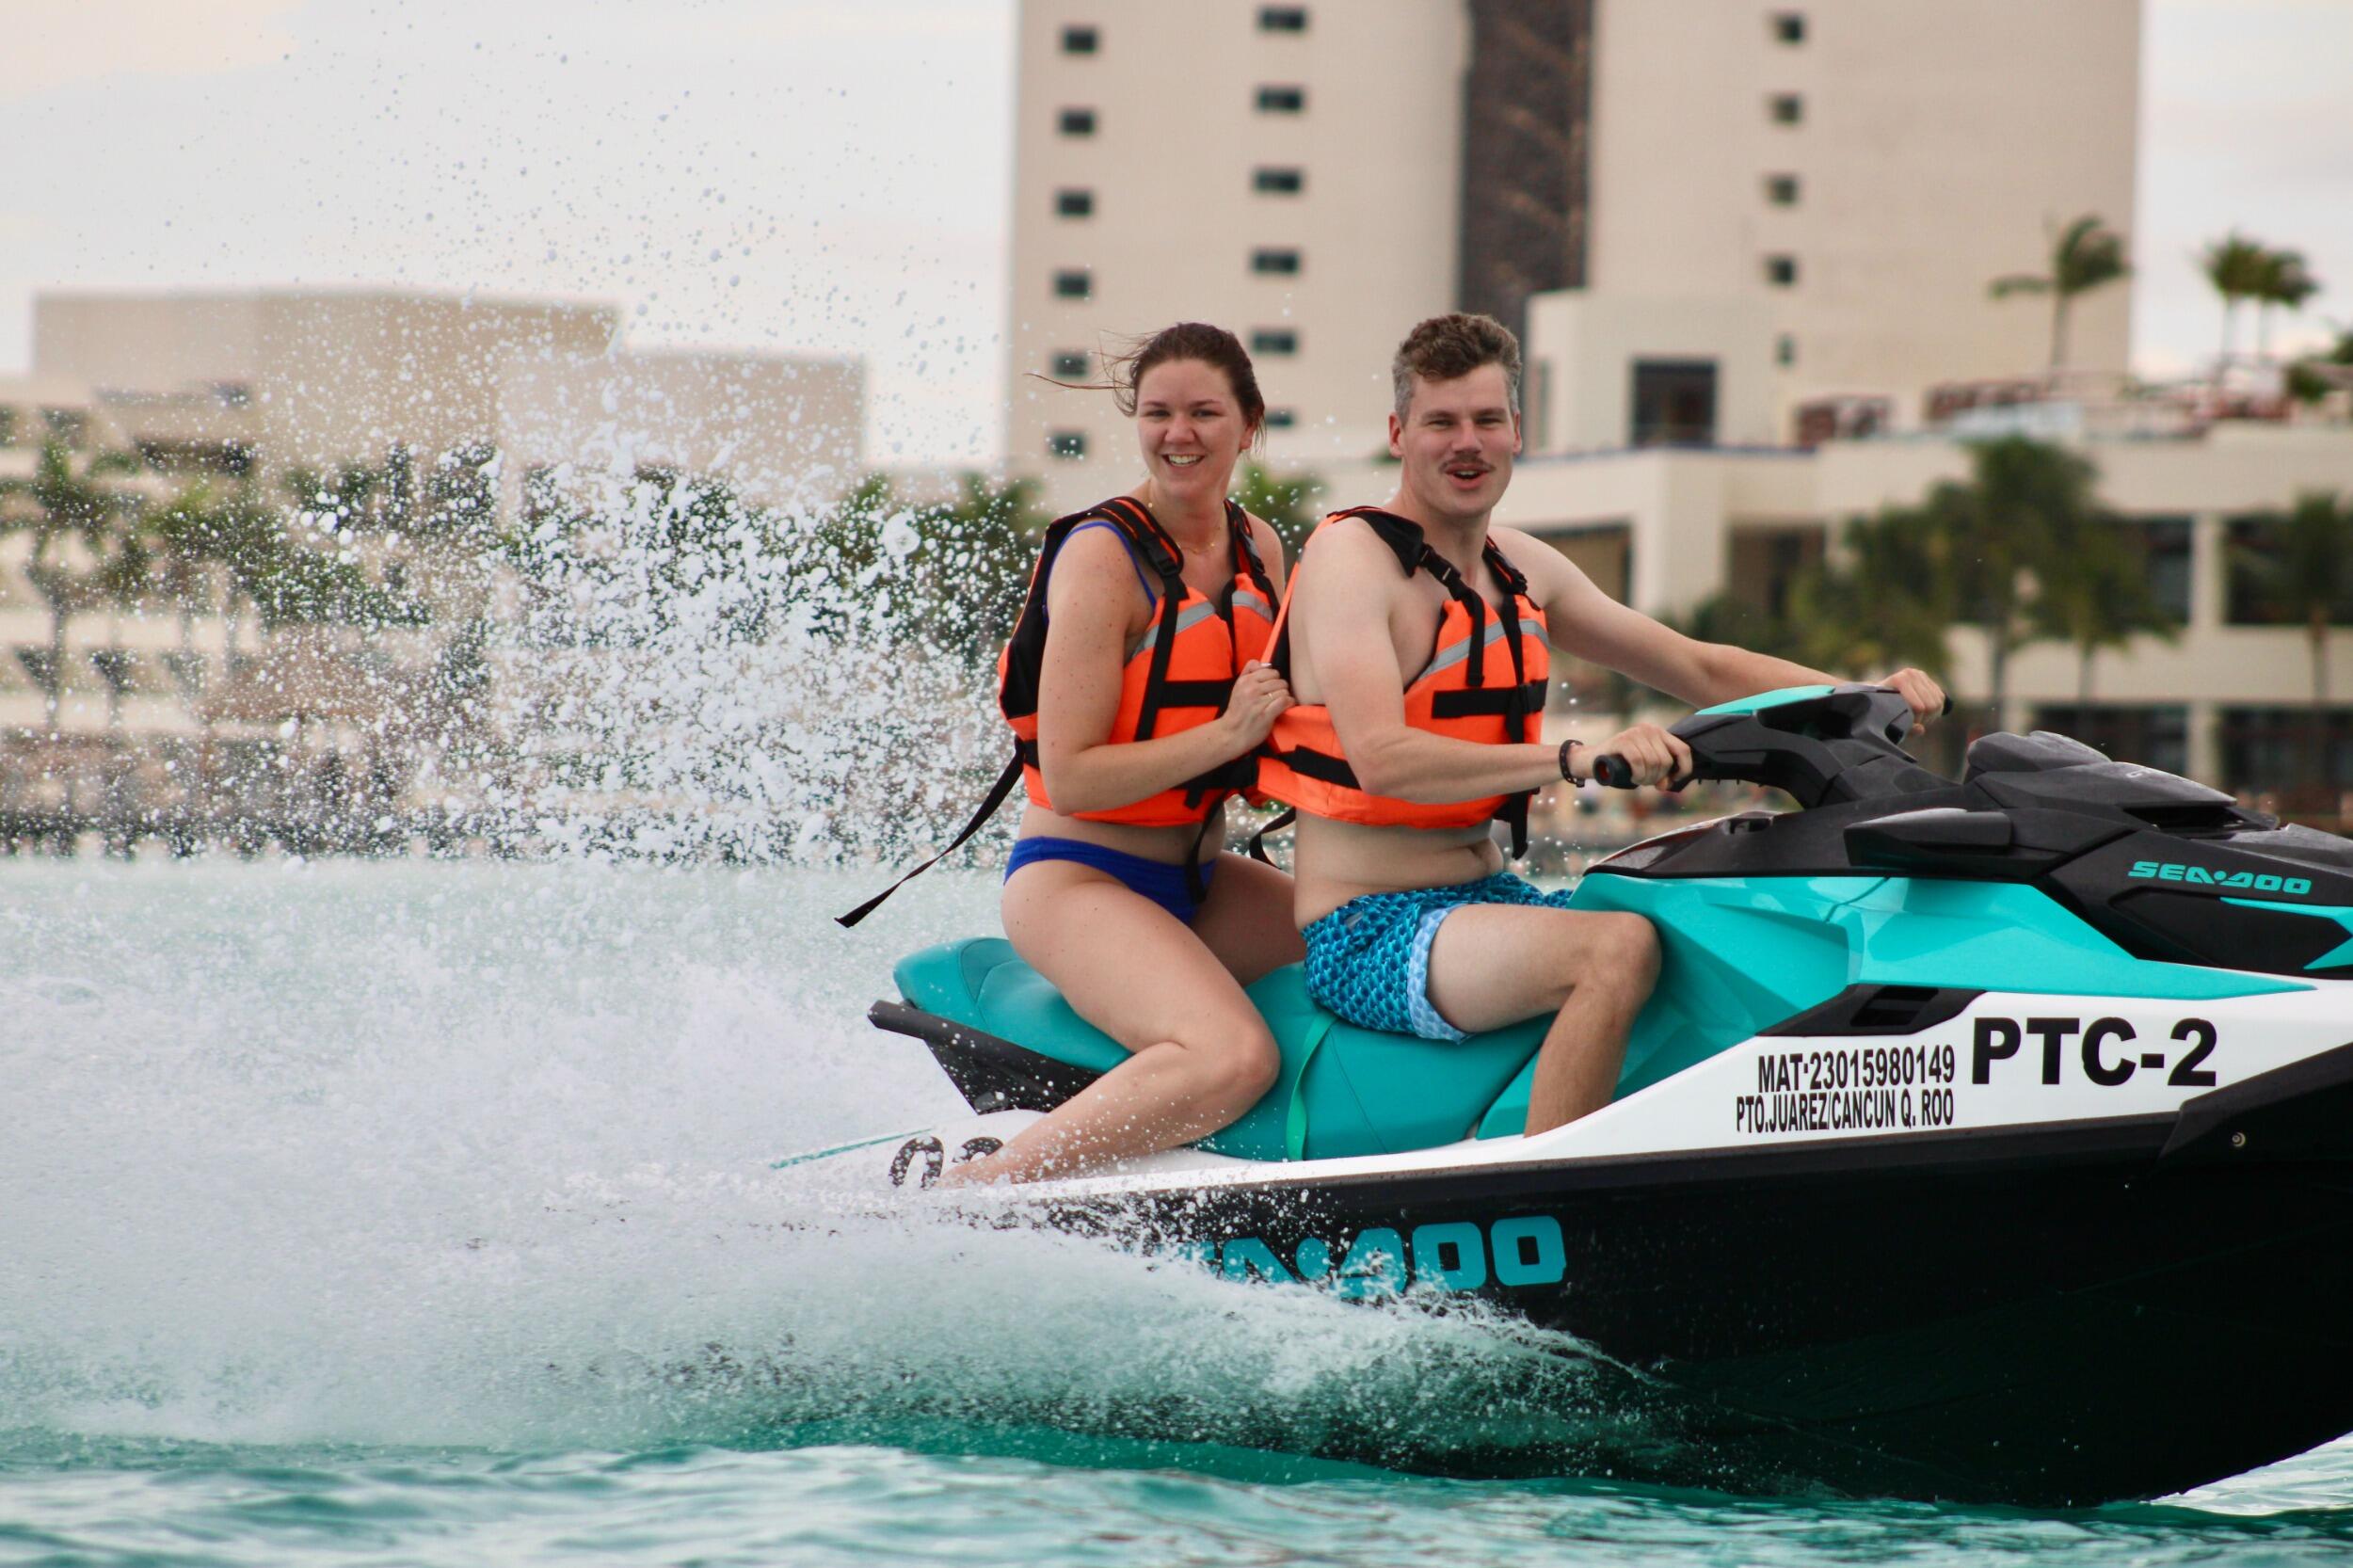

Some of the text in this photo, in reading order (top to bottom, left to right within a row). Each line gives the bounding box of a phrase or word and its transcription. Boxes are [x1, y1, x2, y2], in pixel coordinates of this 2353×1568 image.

[1972, 1016, 2217, 1087] PTC-2
[1900, 1088, 1916, 1129] Q.
[1921, 1088, 1954, 1127] ROO
